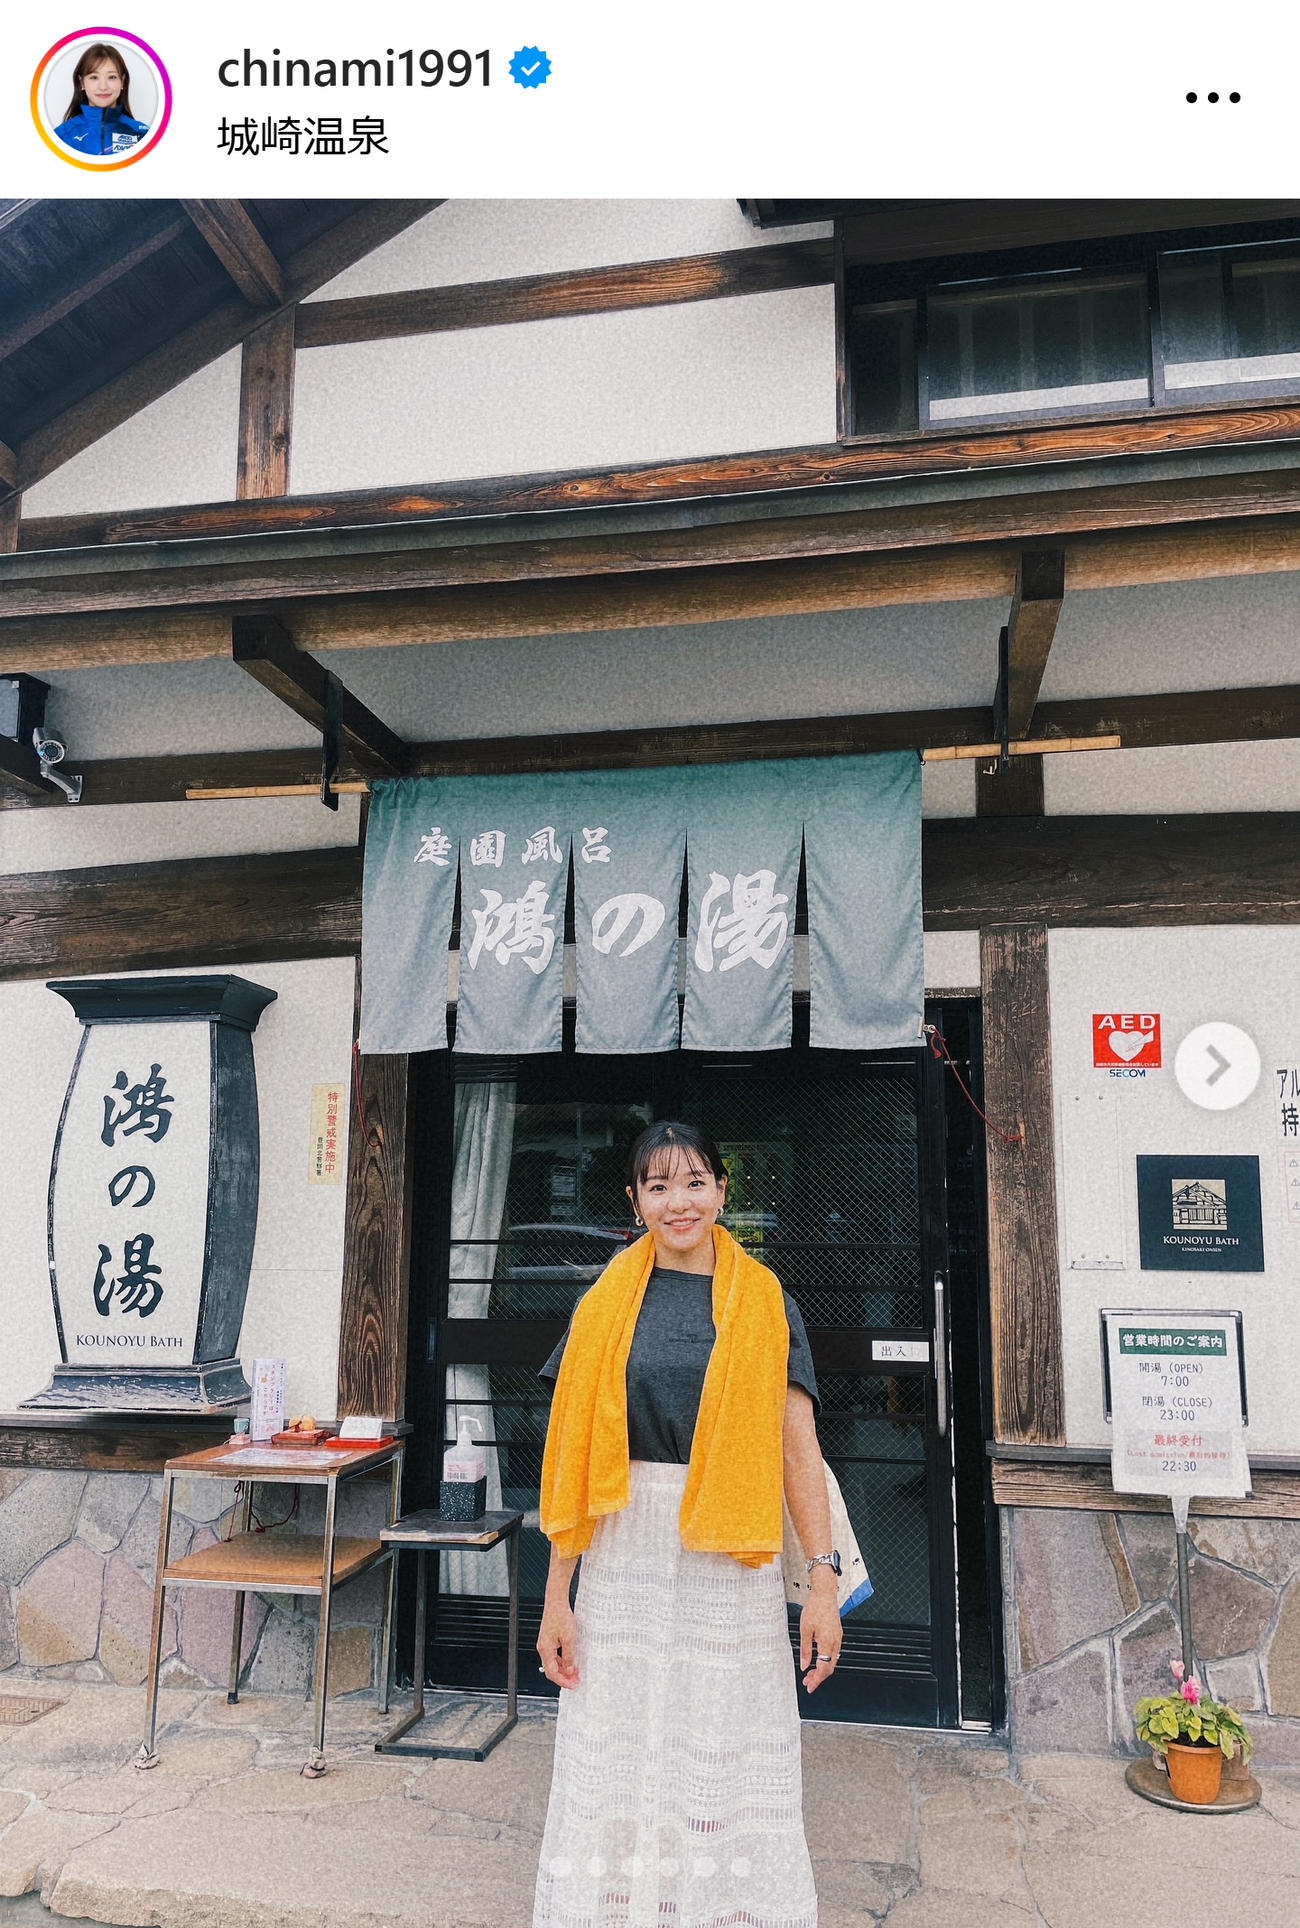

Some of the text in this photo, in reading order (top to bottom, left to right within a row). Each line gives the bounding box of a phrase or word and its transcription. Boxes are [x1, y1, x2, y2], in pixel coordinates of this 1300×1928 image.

[413, 826, 611, 868] 庭園風呂
[466, 868, 790, 974] 鴻の湯
[1097, 1014, 1156, 1030] AED
[1109, 1068, 1146, 1078] SECOM
[325, 1091, 339, 1173] 特別警戒実施中
[92, 1062, 175, 1319] 鴻の湯
[1163, 1235, 1240, 1246] KOUNOYU BATH
[76, 1334, 183, 1348] KOUNOYU BATH
[1122, 1333, 1224, 1348] 営業時間のご案内
[1160, 1375, 1190, 1388] 7:00
[1160, 1409, 1195, 1422] 23:00
[1154, 1434, 1203, 1447] 最終受付
[1161, 1460, 1197, 1473] 22:30
